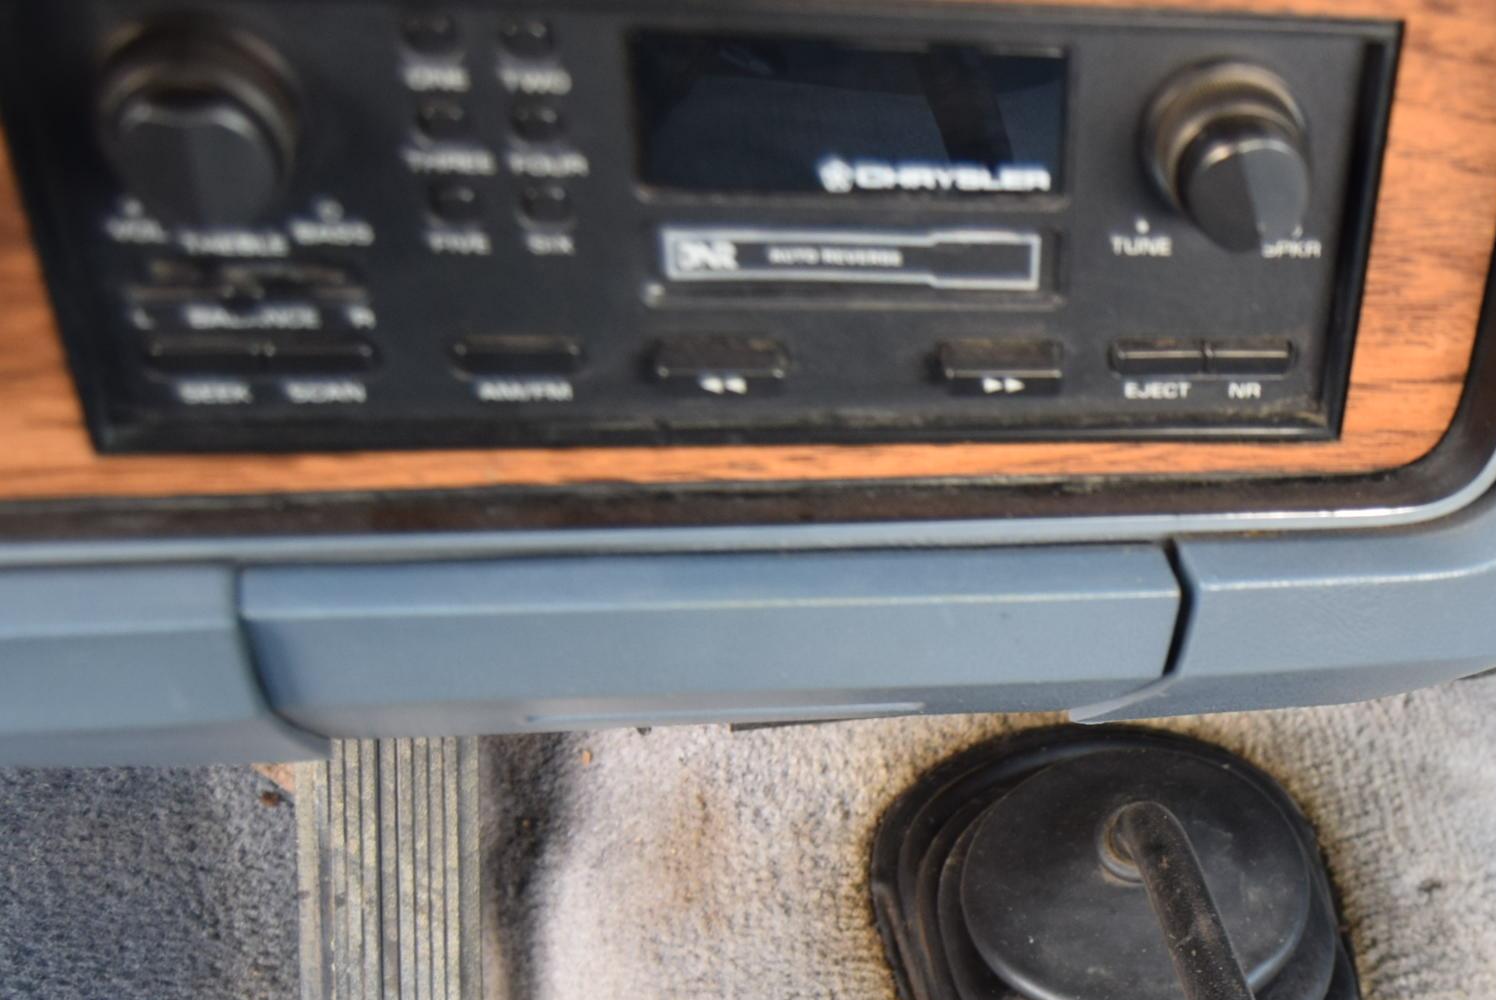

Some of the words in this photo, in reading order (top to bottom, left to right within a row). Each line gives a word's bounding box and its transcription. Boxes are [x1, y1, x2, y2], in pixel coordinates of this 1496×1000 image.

[855, 163, 1051, 191] CHRYSLER
[1111, 235, 1172, 257] TUNE
[1124, 382, 1191, 400] EJECT
[1228, 382, 1262, 400] NR
